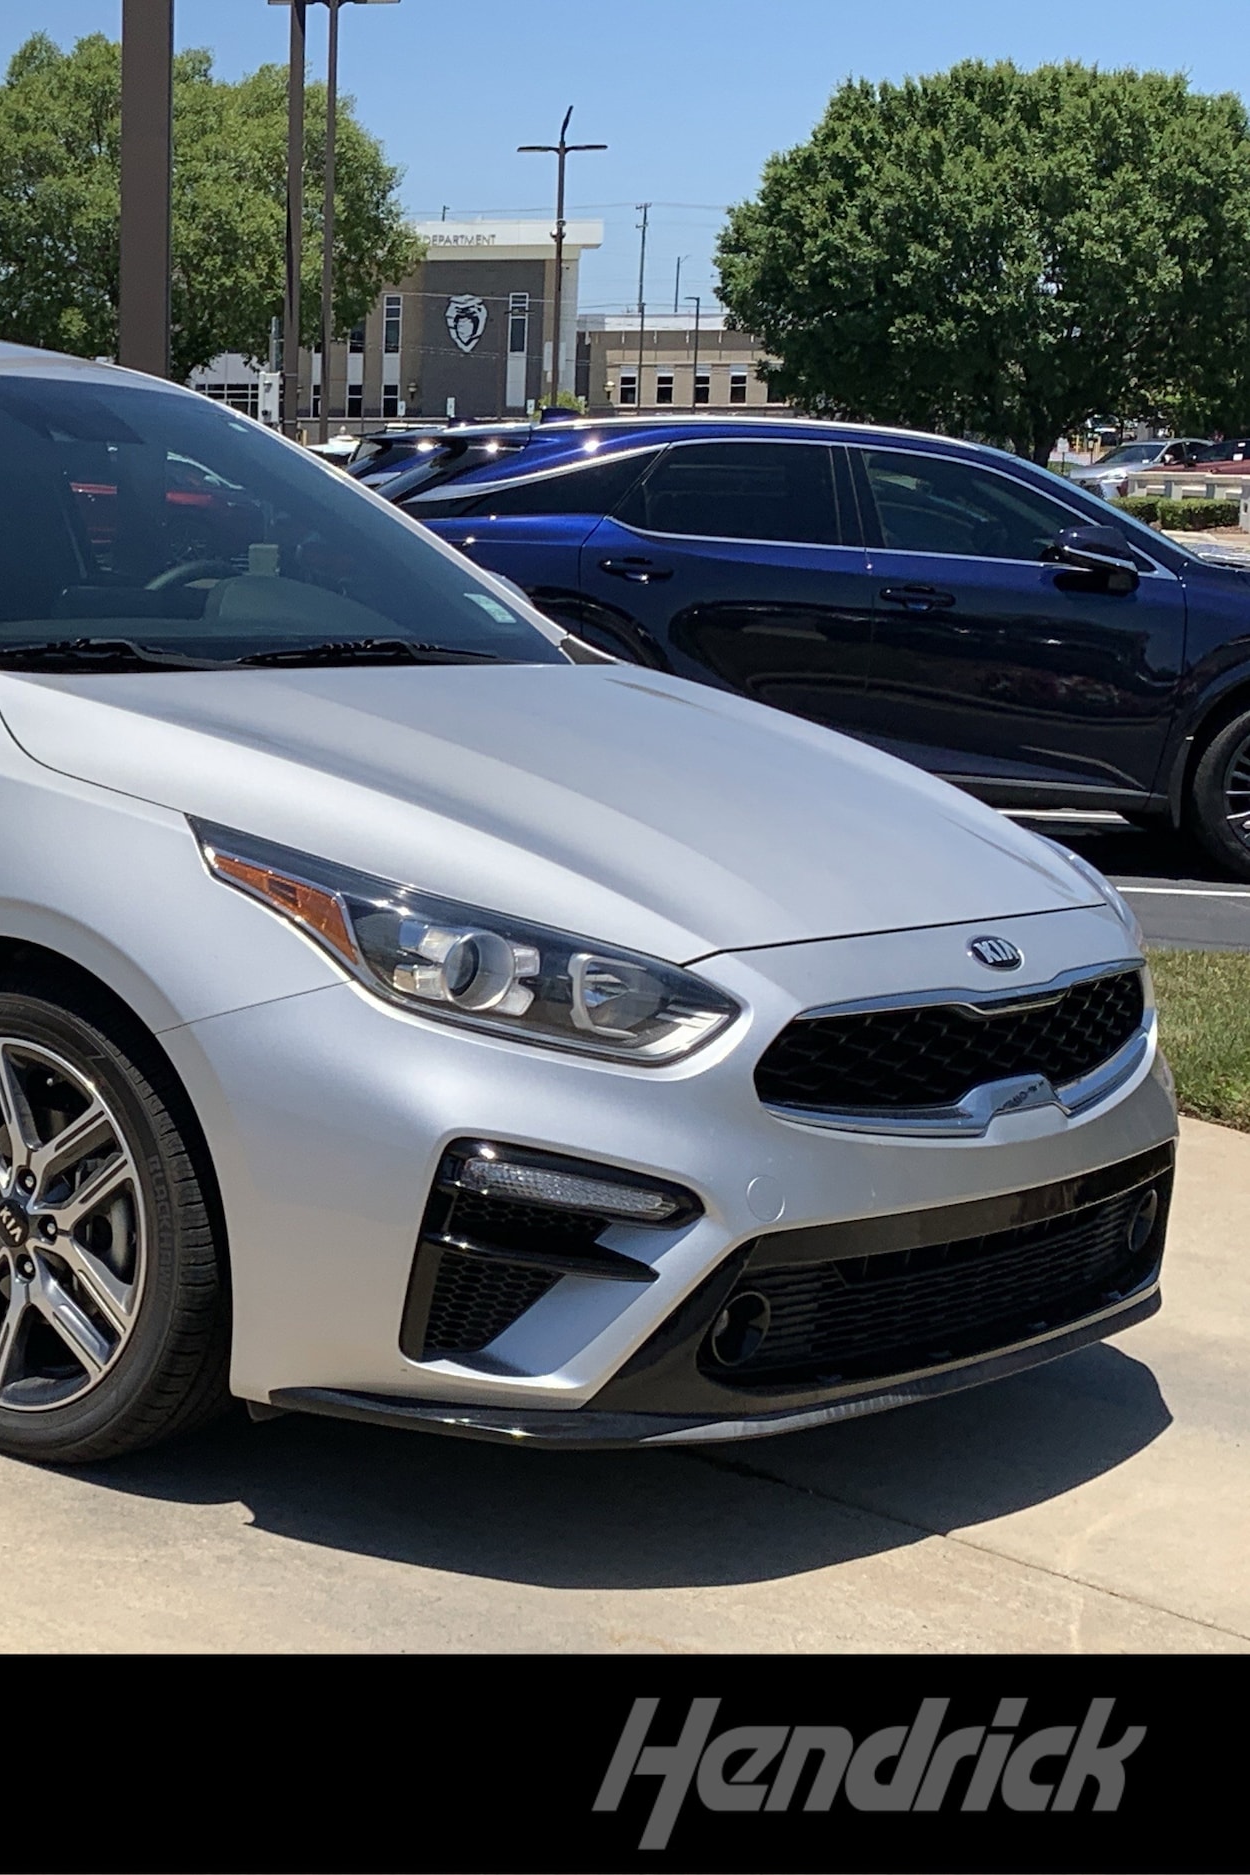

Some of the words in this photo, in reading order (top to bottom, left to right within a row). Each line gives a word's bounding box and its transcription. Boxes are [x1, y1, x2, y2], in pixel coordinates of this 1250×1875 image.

[423, 234, 496, 246] DEPARTMENT
[973, 939, 1020, 964] KIA
[0, 1205, 23, 1243] KIA
